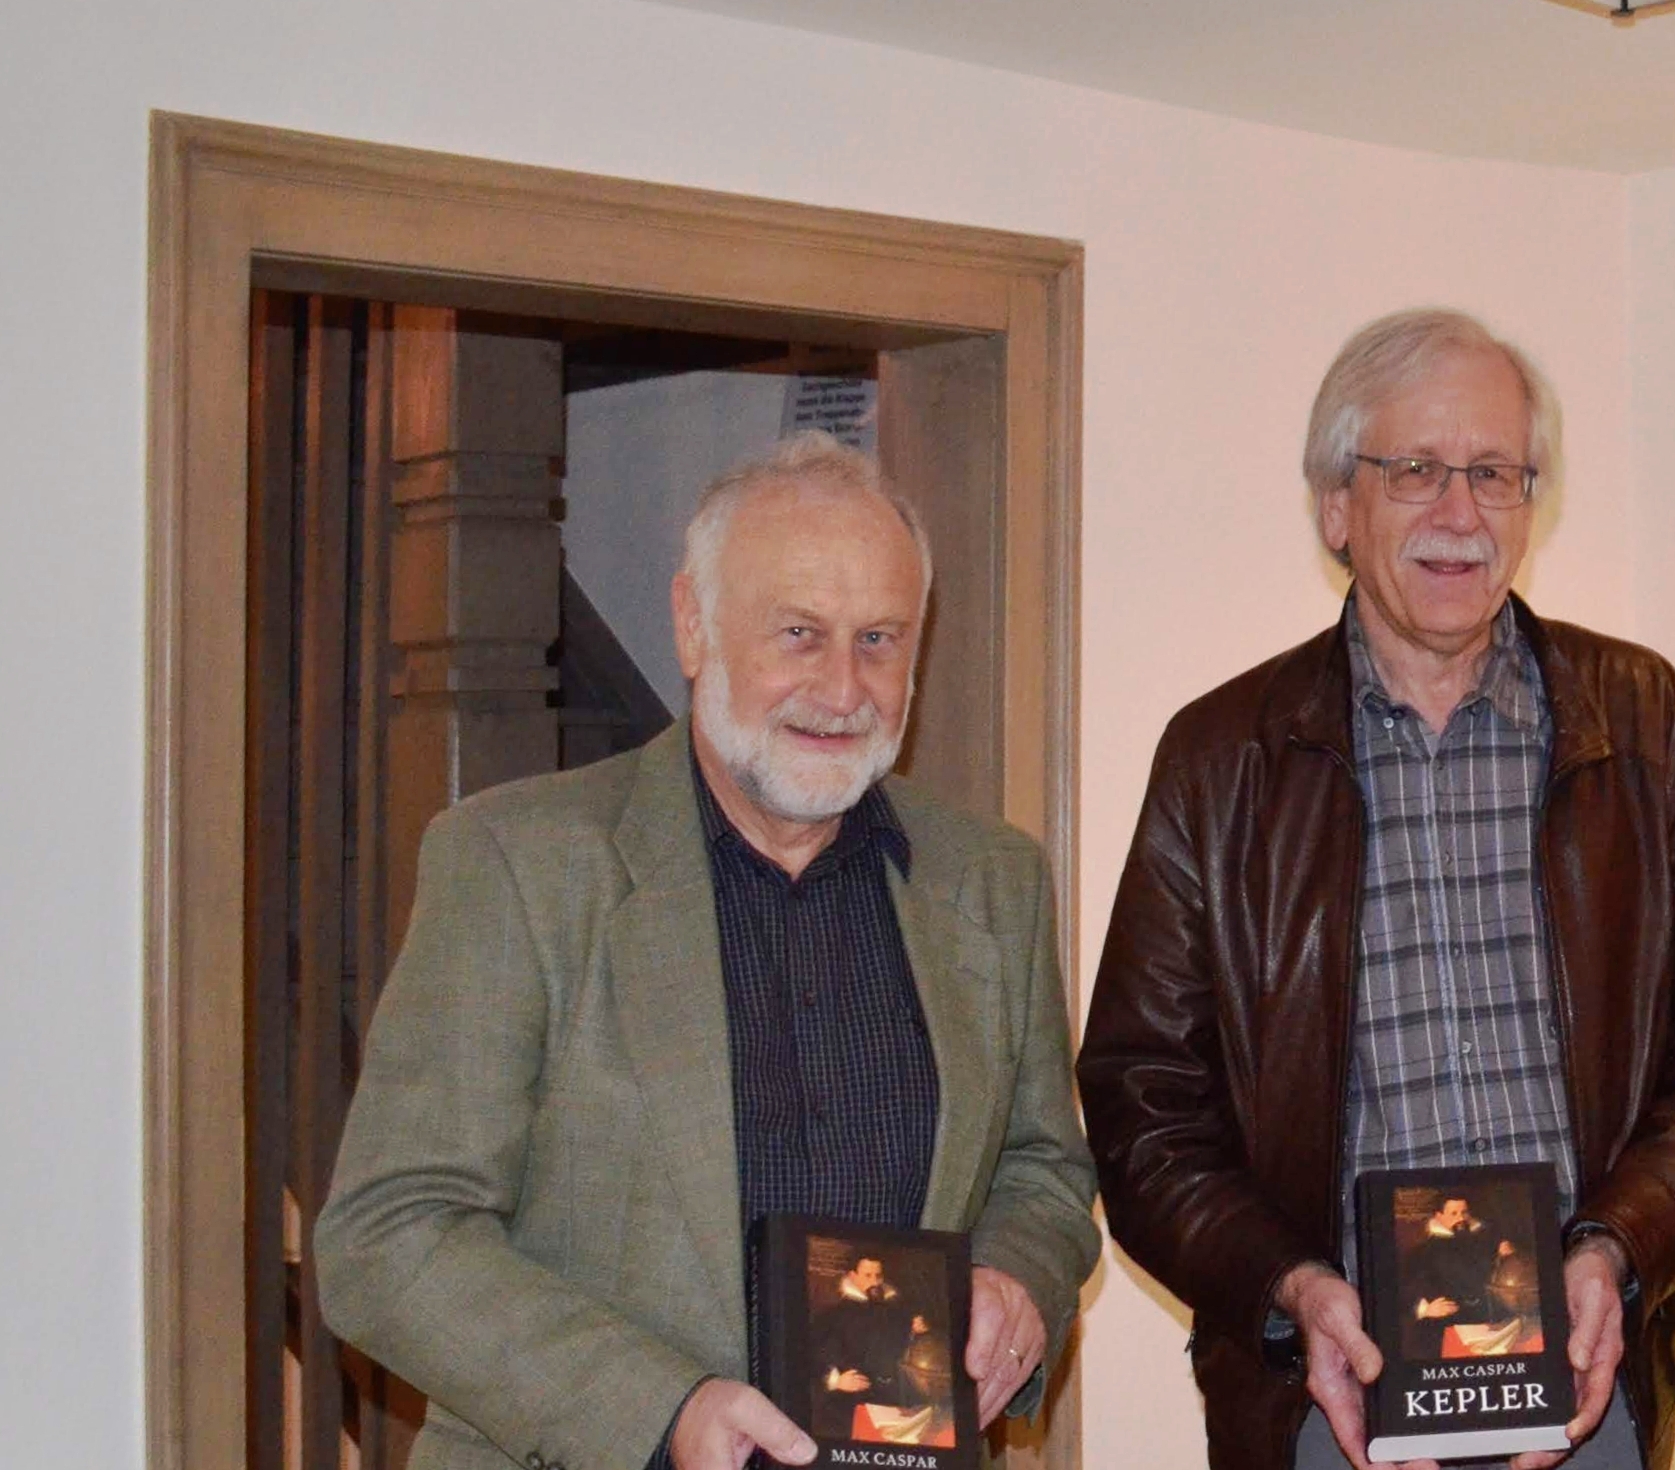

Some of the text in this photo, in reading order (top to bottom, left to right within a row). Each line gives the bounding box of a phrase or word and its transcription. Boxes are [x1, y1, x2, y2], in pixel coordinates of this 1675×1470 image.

[1422, 1362, 1527, 1381] MAX CASPAR
[1405, 1383, 1549, 1418] KEPLER
[831, 1449, 938, 1469] MAX CASPAR
